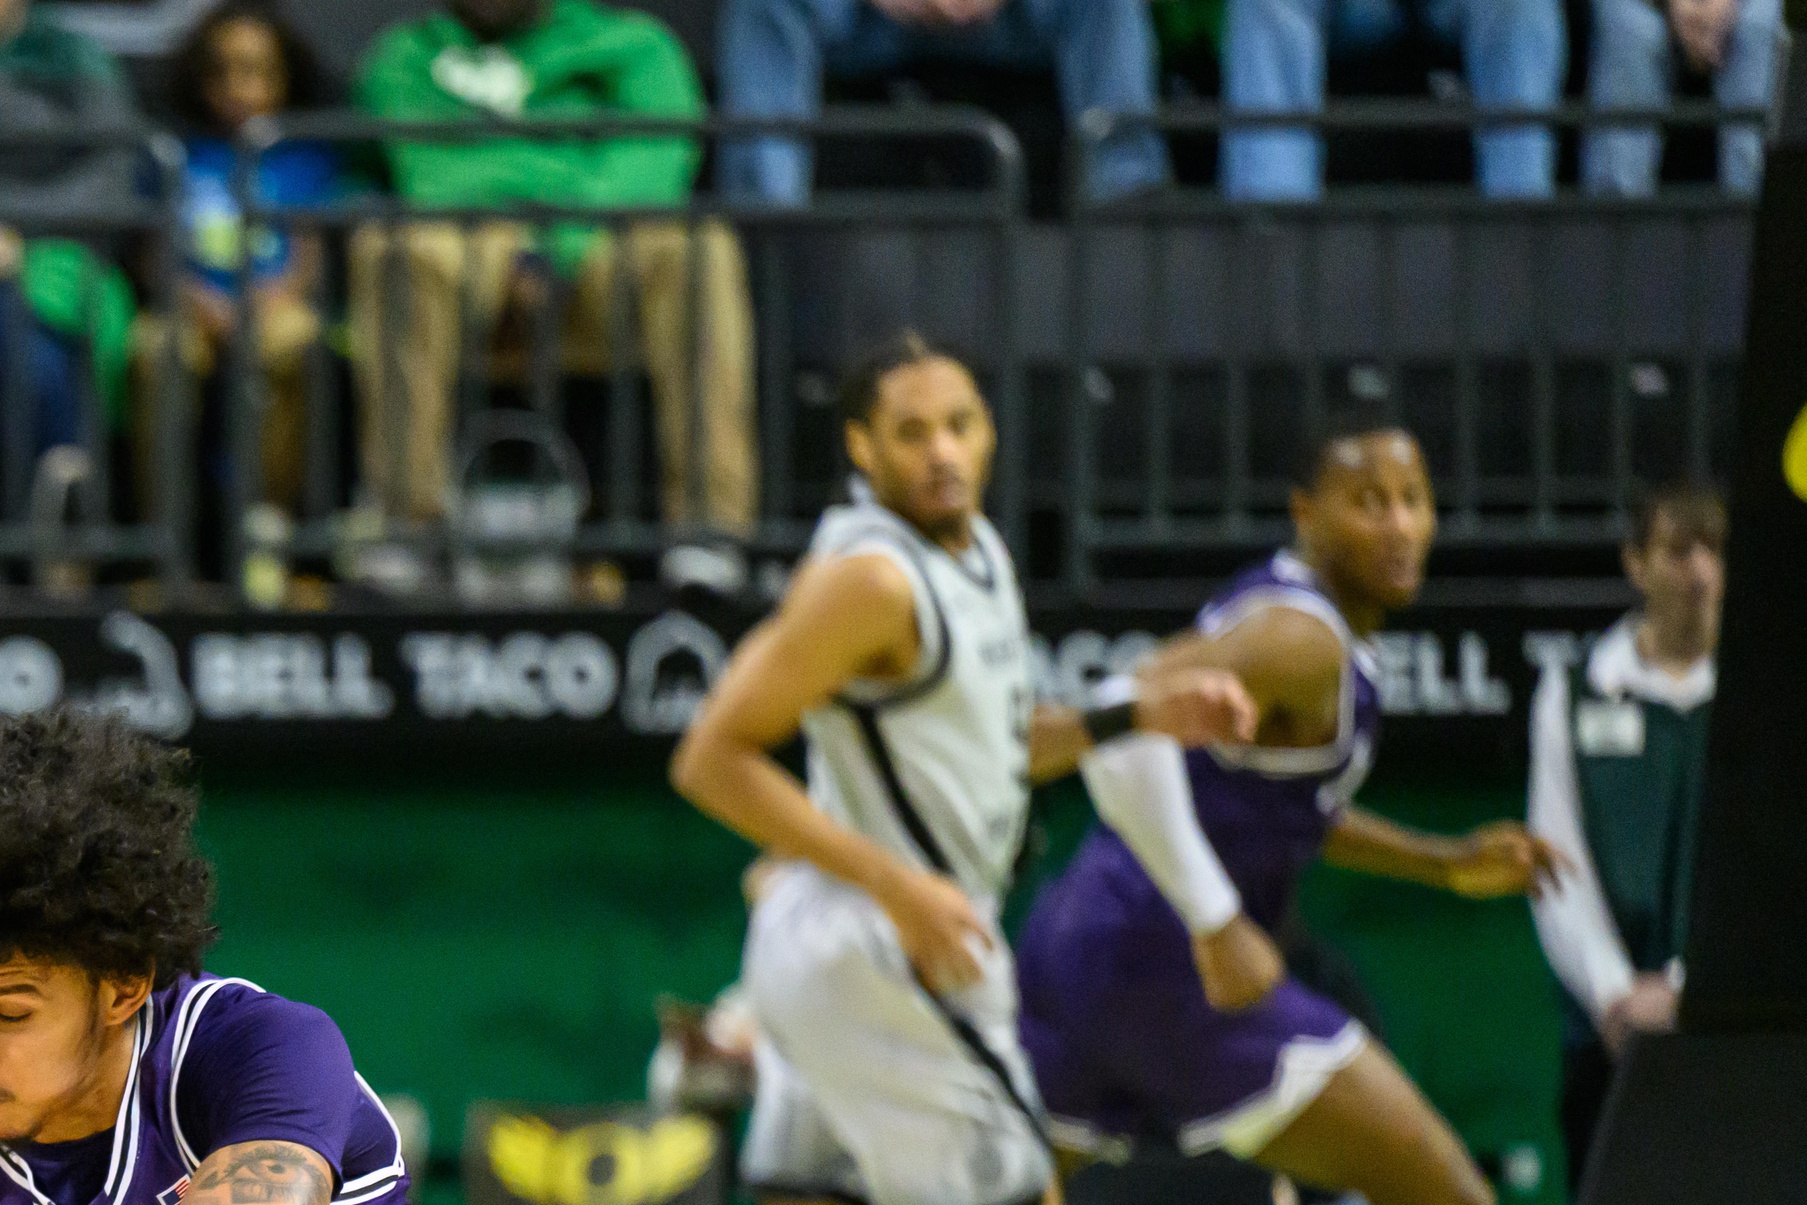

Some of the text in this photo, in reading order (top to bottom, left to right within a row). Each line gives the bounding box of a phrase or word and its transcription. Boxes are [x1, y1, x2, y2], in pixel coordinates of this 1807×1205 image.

[193, 632, 391, 718] BELL
[397, 631, 619, 719] TACO
[1364, 632, 1511, 715] ELL
